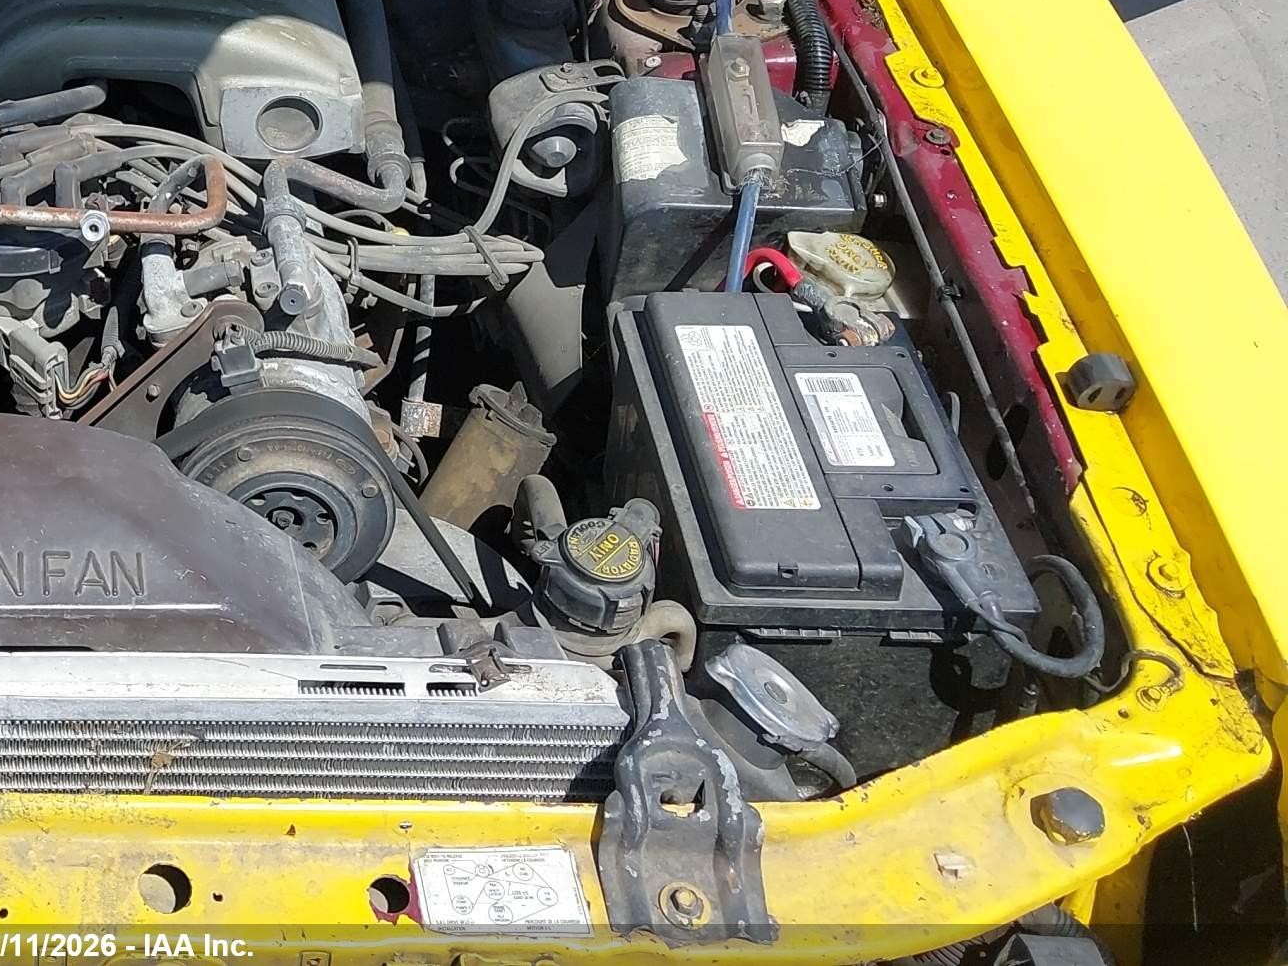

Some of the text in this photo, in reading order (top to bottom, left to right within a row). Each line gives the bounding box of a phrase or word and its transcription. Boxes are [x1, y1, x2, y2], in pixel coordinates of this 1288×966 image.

[588, 533, 620, 562] ONLY
[601, 538, 639, 575] RADIATOR
[41, 550, 145, 597] FAN
